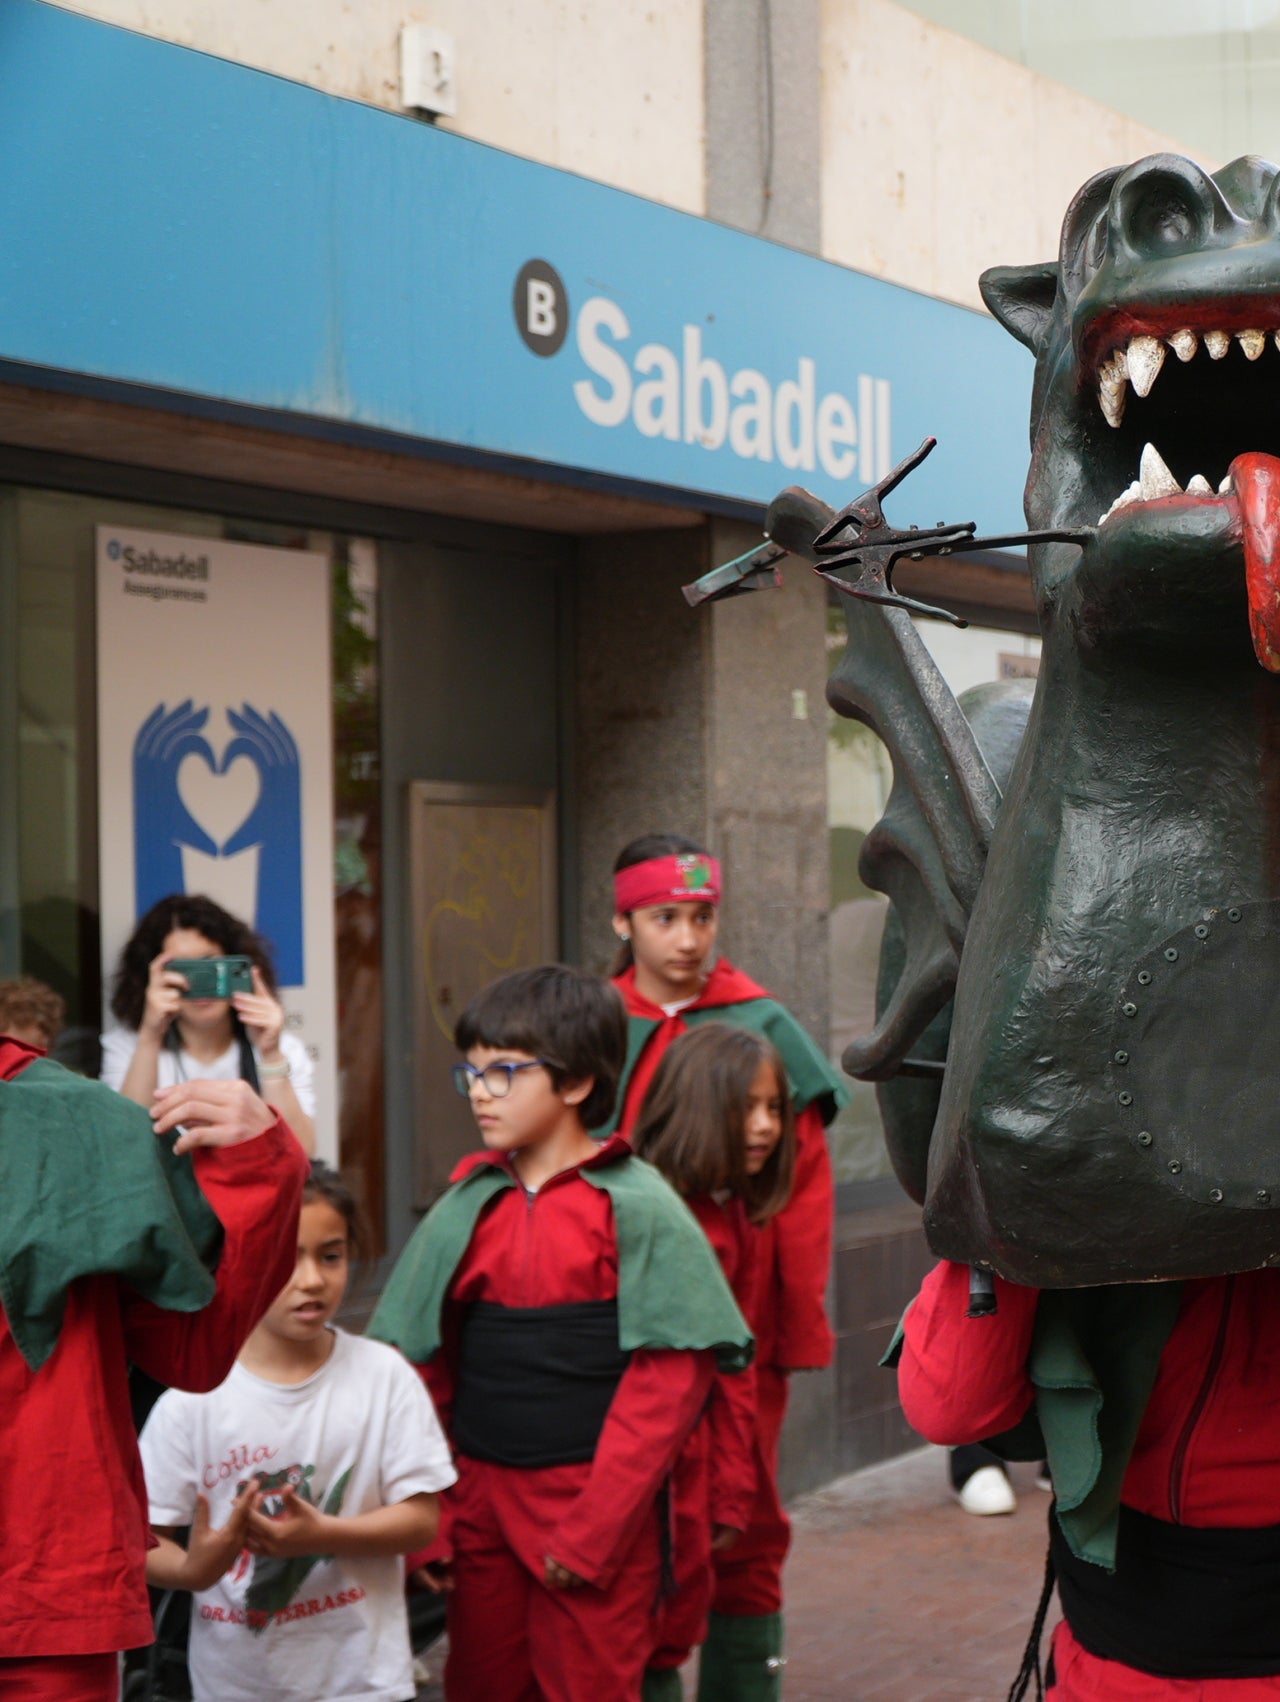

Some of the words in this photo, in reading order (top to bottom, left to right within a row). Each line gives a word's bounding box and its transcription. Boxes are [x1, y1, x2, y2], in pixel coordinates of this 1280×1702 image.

[526, 277, 558, 337] B
[573, 296, 892, 485] Sabadell
[122, 545, 209, 583] Sabadell
[203, 1444, 280, 1489] Colla
